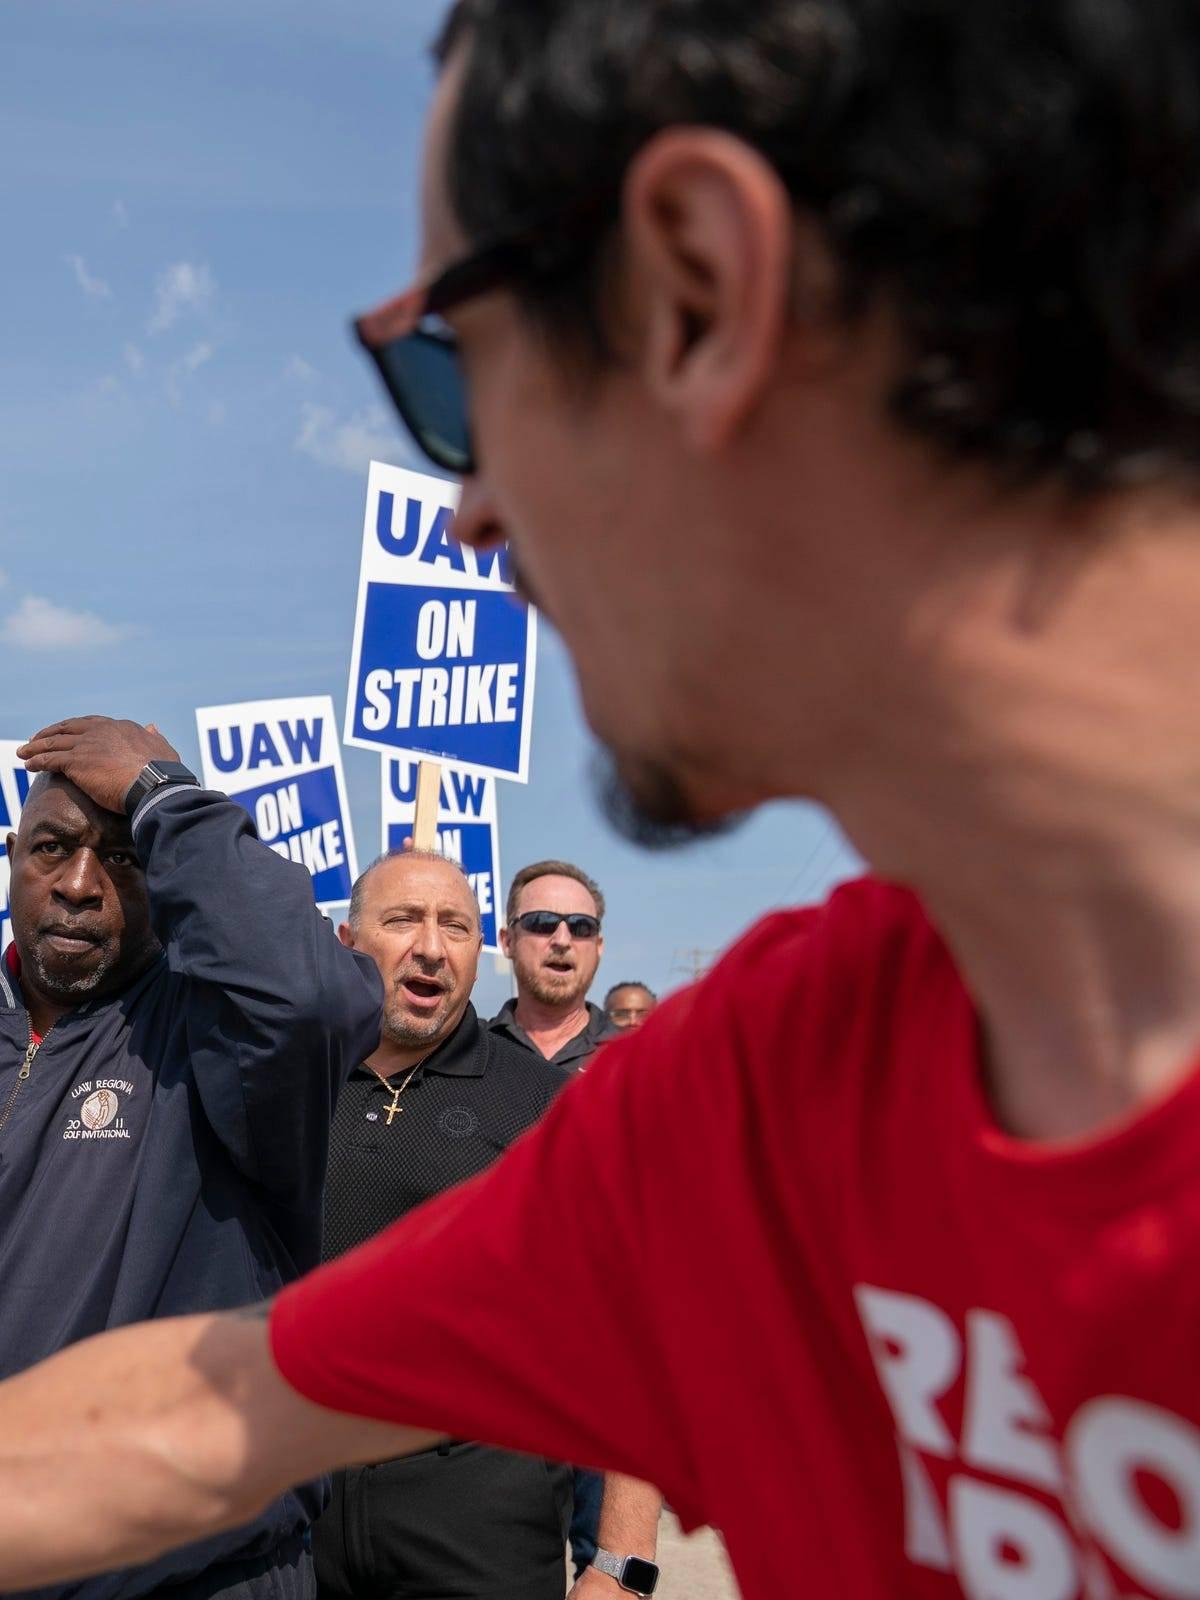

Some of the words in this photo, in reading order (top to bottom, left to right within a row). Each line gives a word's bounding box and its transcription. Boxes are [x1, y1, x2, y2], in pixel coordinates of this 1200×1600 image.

[416, 600, 476, 660] ON
[362, 663, 518, 731] STRIKE
[208, 717, 324, 773] UAW
[255, 783, 303, 841] ON
[71, 1081, 92, 1098] UAW
[96, 1080, 127, 1090] REGION
[63, 1130, 80, 1139] GOLF
[81, 1129, 130, 1139] INVITATIONAL
[67, 1120, 80, 1130] 20
